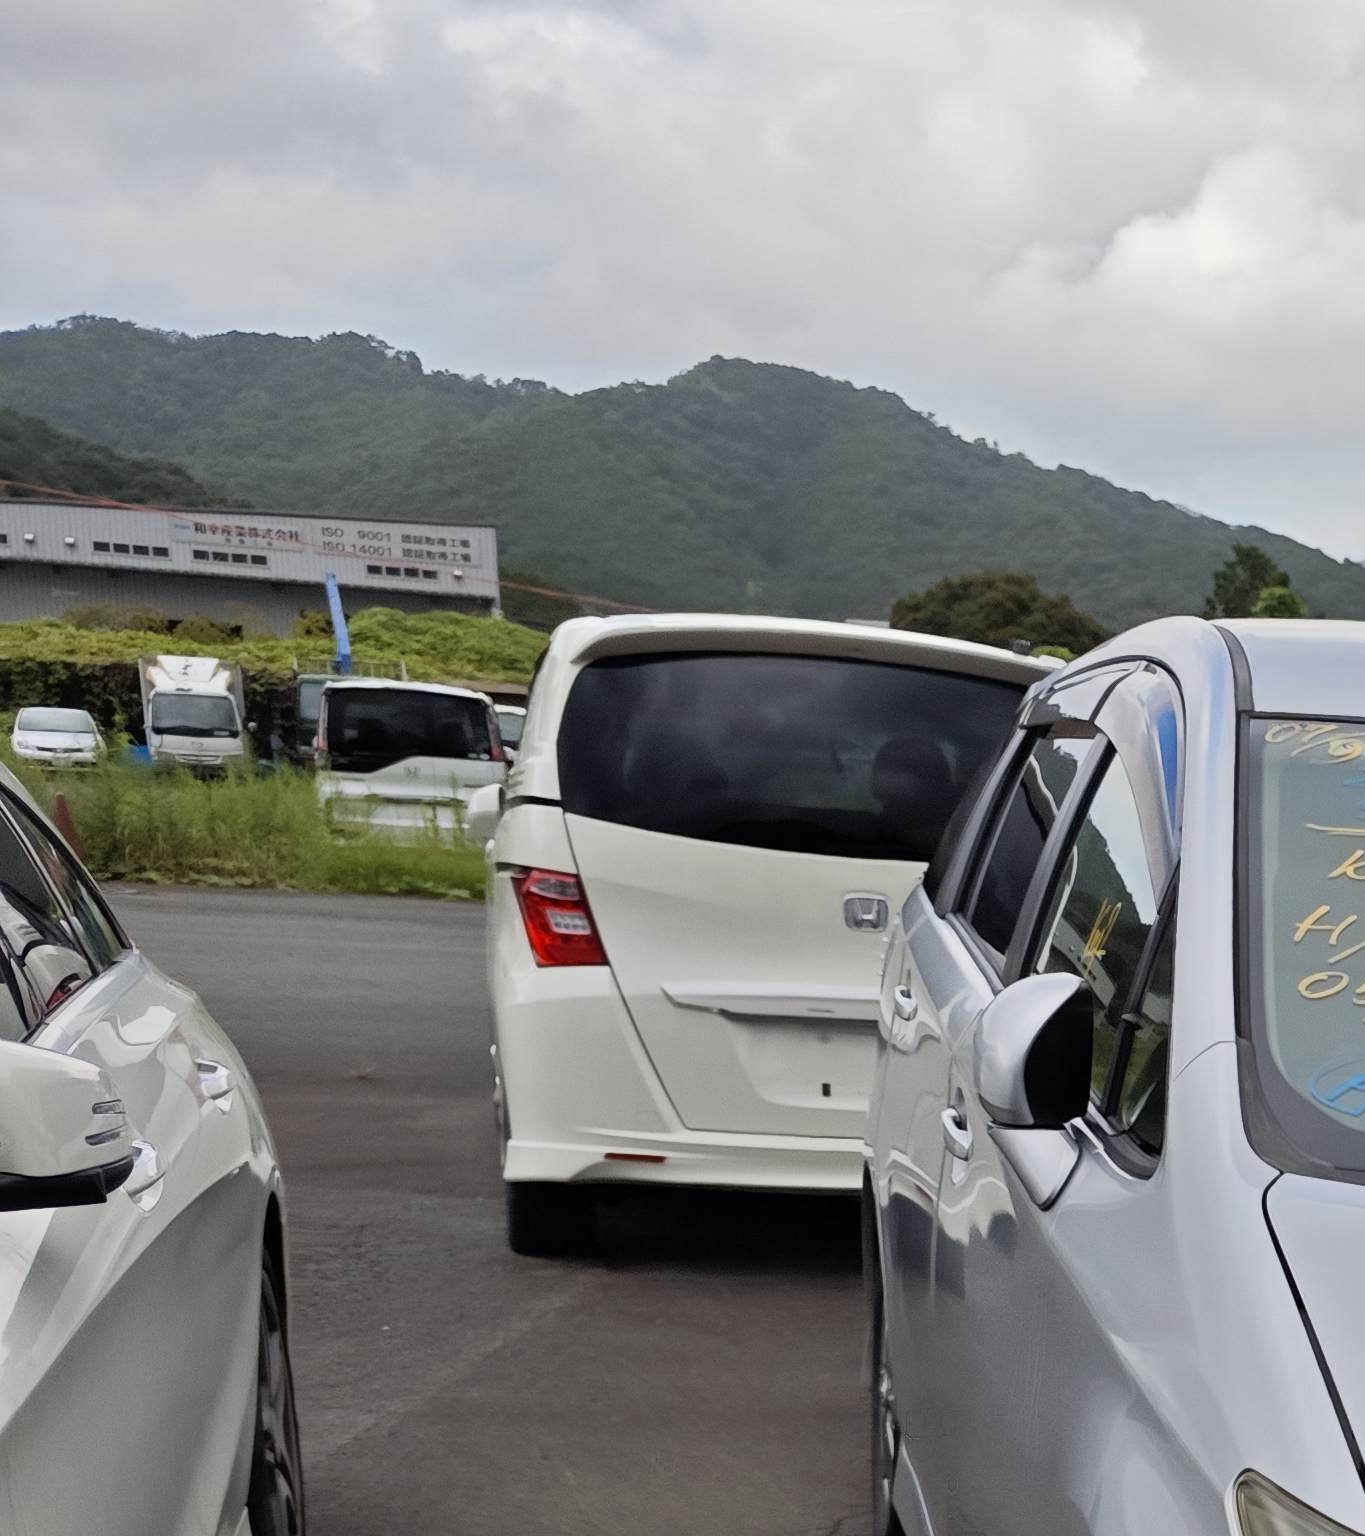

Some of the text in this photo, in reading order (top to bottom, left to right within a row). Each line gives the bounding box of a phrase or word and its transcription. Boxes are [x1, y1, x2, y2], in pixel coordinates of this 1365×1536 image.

[321, 527, 344, 538] ISO
[357, 530, 392, 542] 9001
[322, 541, 345, 553] ISO
[351, 544, 392, 556] 14001
